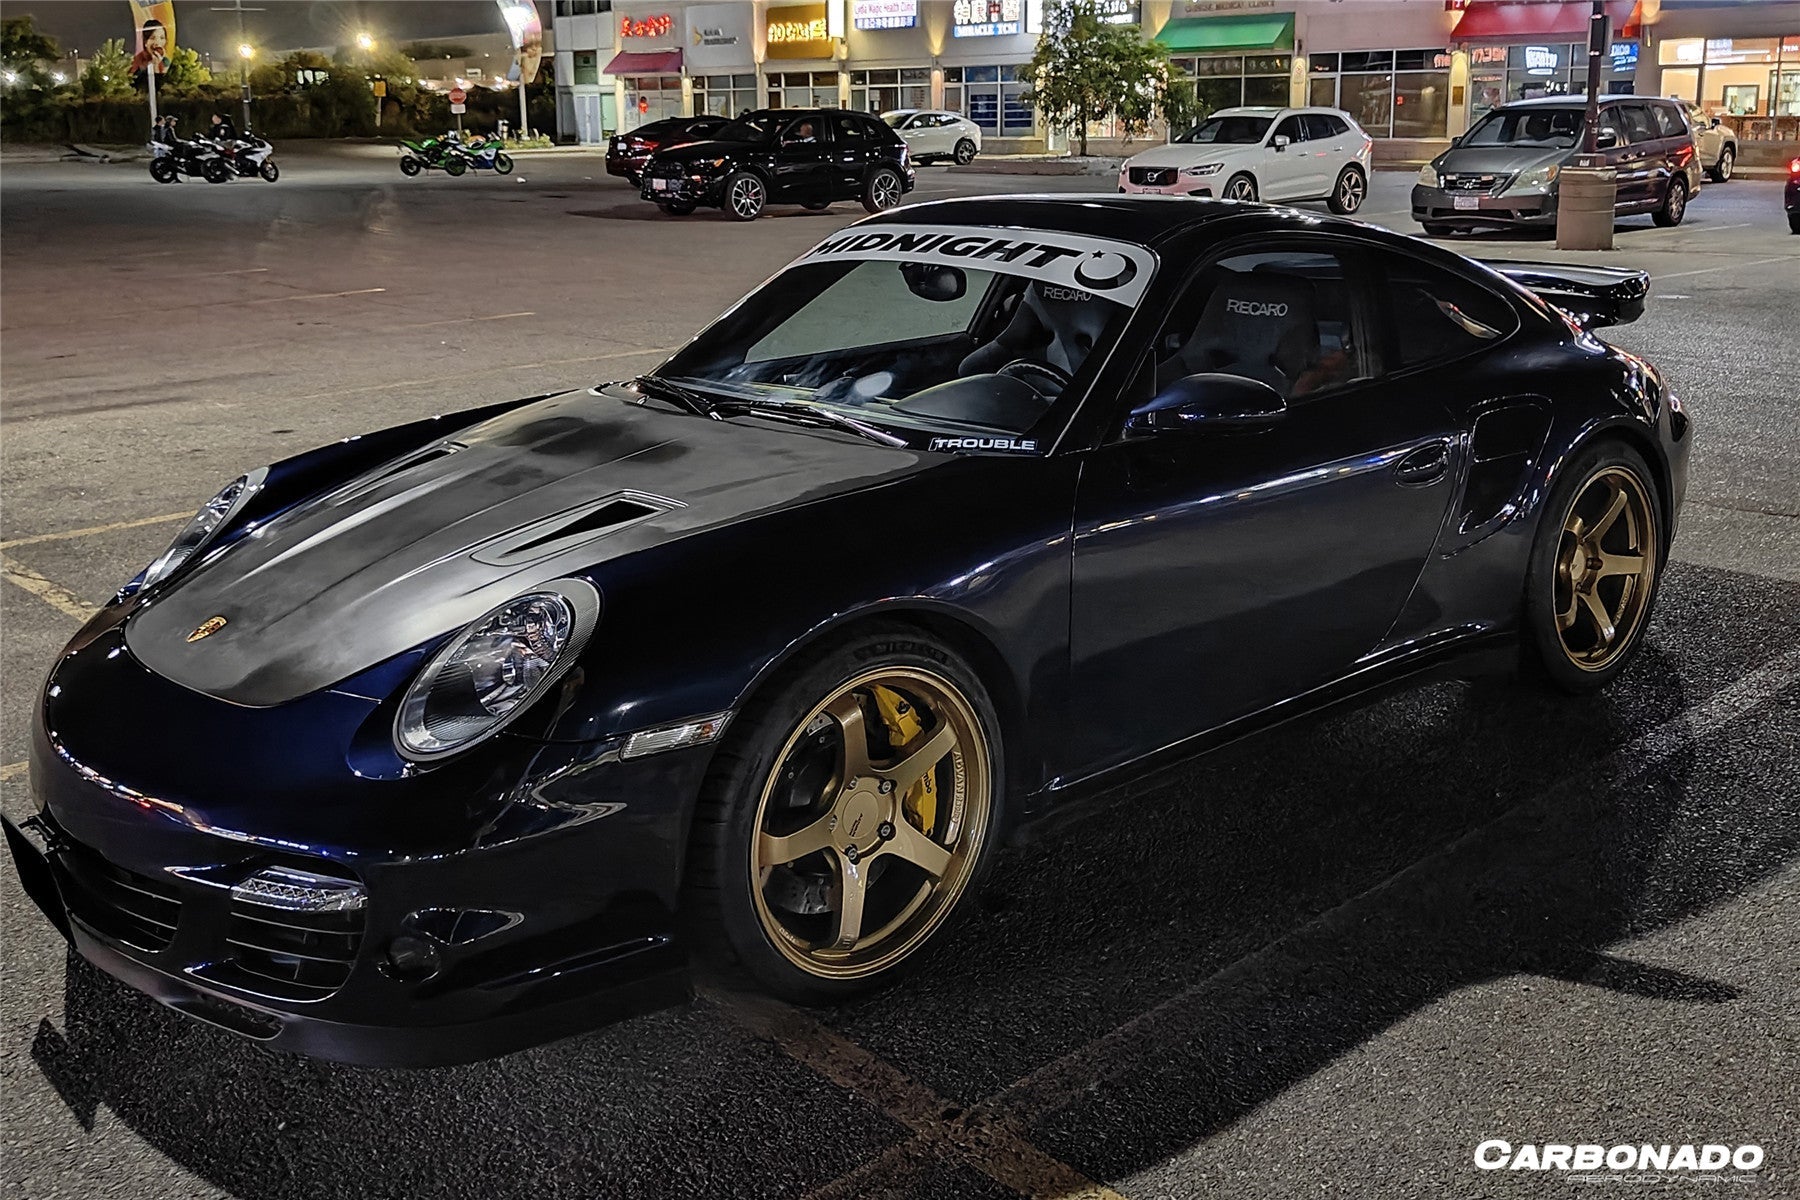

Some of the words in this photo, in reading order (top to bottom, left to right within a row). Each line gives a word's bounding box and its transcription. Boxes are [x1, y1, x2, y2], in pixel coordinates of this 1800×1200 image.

[901, 1, 914, 11] Clinic
[812, 233, 1083, 269] MIDNIGHT
[1226, 299, 1288, 317] RECARO
[934, 438, 1036, 451] TROUBLE
[952, 750, 965, 794] ADVAN
